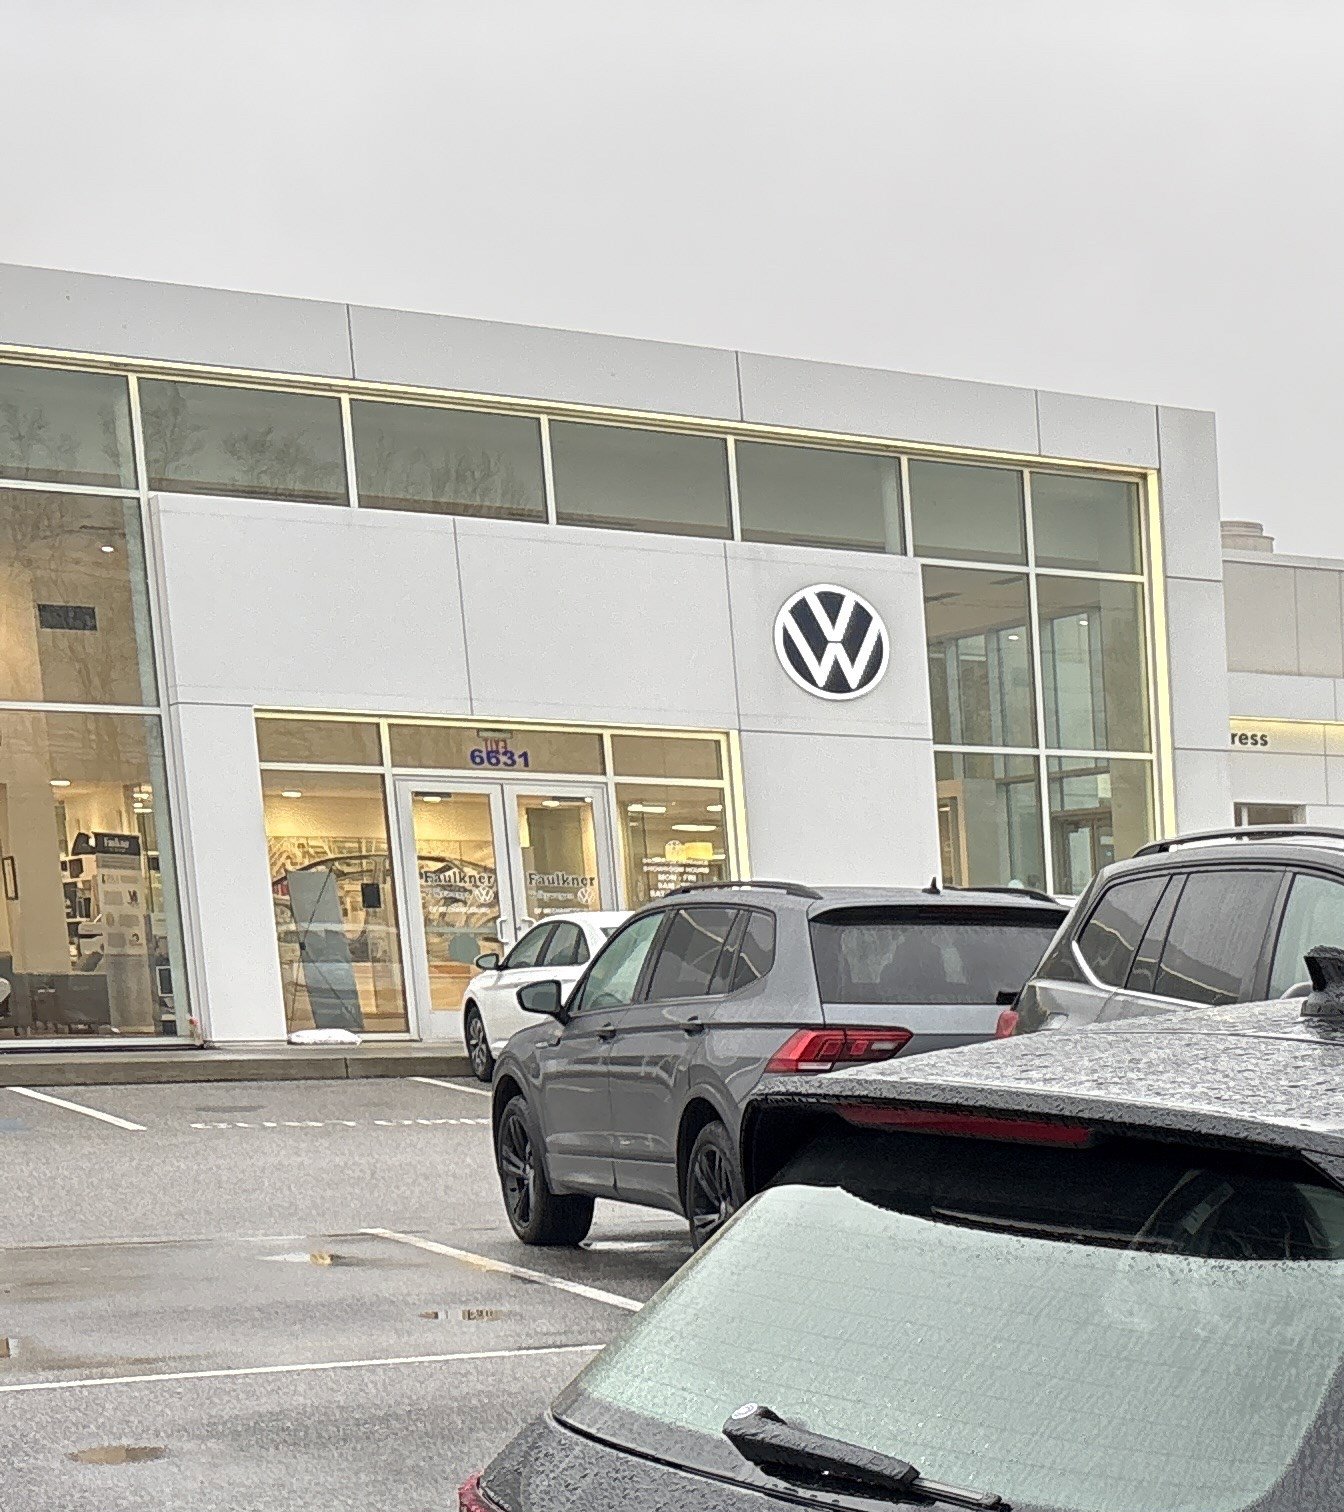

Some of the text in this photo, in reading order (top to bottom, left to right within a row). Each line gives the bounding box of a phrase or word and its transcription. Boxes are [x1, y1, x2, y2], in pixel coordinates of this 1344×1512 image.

[774, 583, 889, 700] VW
[1230, 732, 1268, 746] ress
[470, 748, 530, 768] 6631
[422, 870, 495, 885] Faulkner
[528, 872, 596, 887] Faulkner
